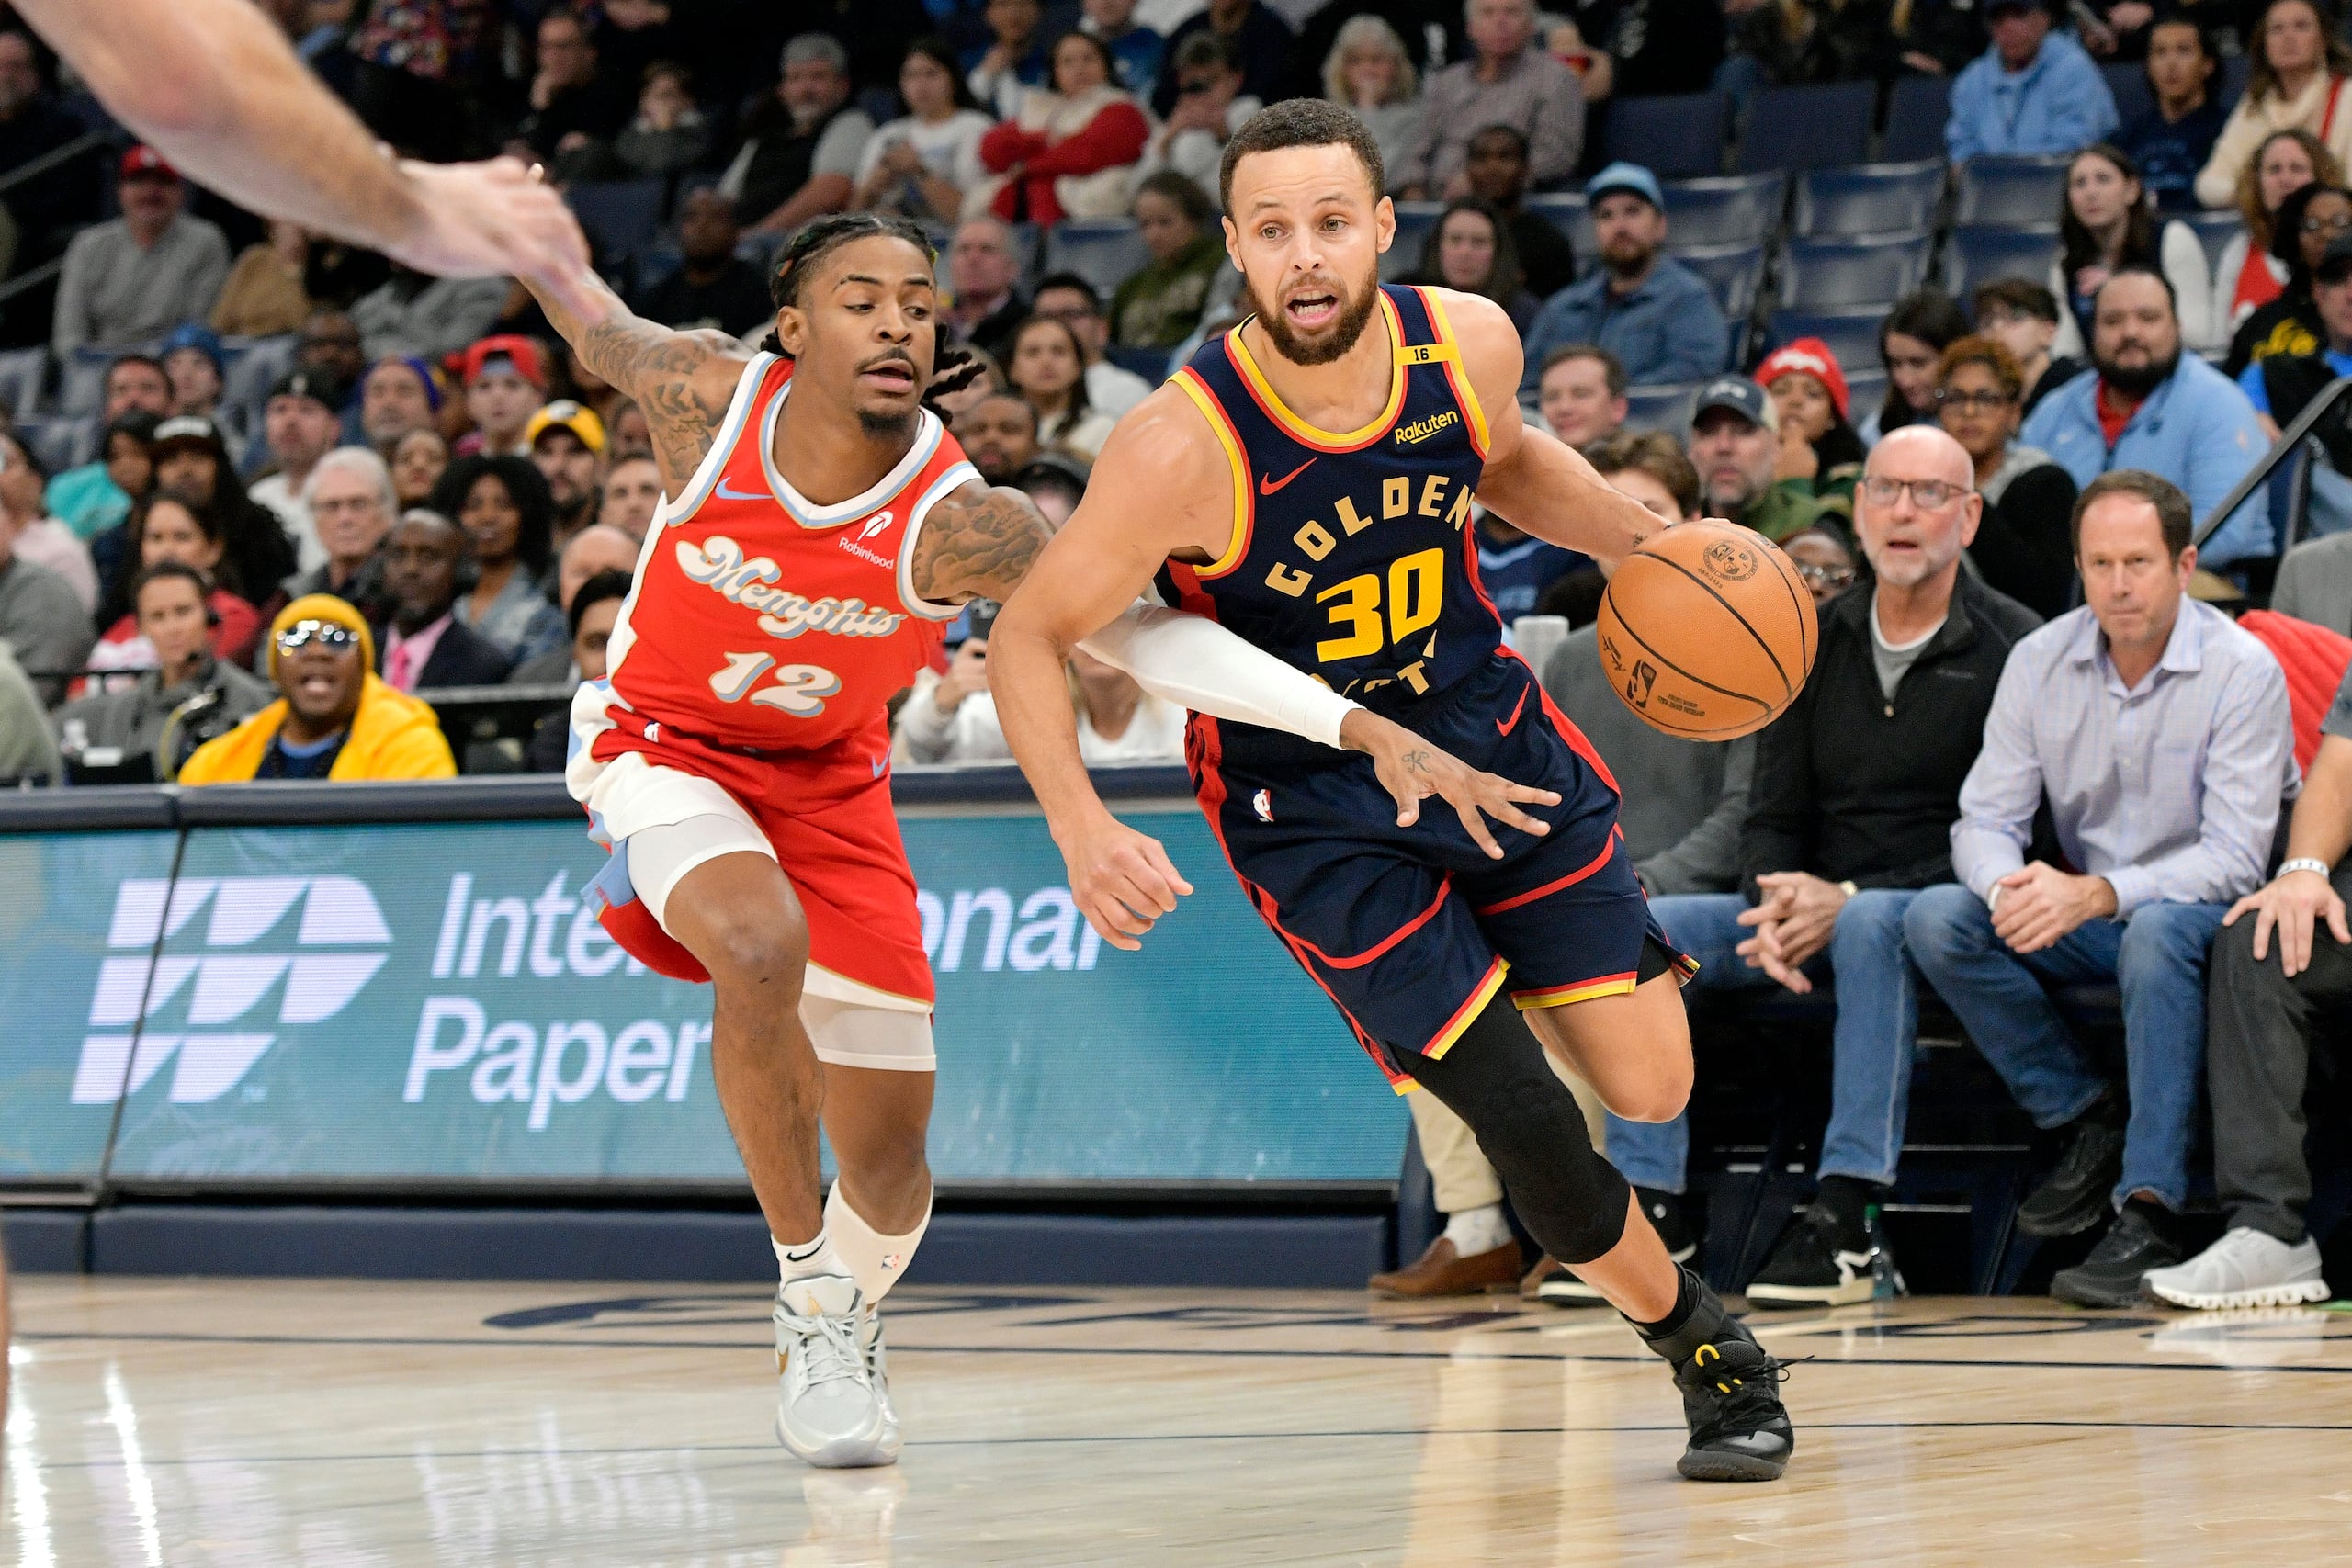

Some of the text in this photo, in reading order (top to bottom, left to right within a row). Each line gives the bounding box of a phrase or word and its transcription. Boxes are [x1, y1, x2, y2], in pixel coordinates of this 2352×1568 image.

[1414, 347, 1430, 362] 16
[1395, 410, 1459, 445] Rakuten
[838, 536, 895, 570] Robinhood
[1264, 474, 1476, 598] GOLDEN
[675, 535, 909, 640] Memphis
[1316, 547, 1444, 663] 30
[708, 650, 842, 718] 12
[401, 994, 714, 1133] Paper
